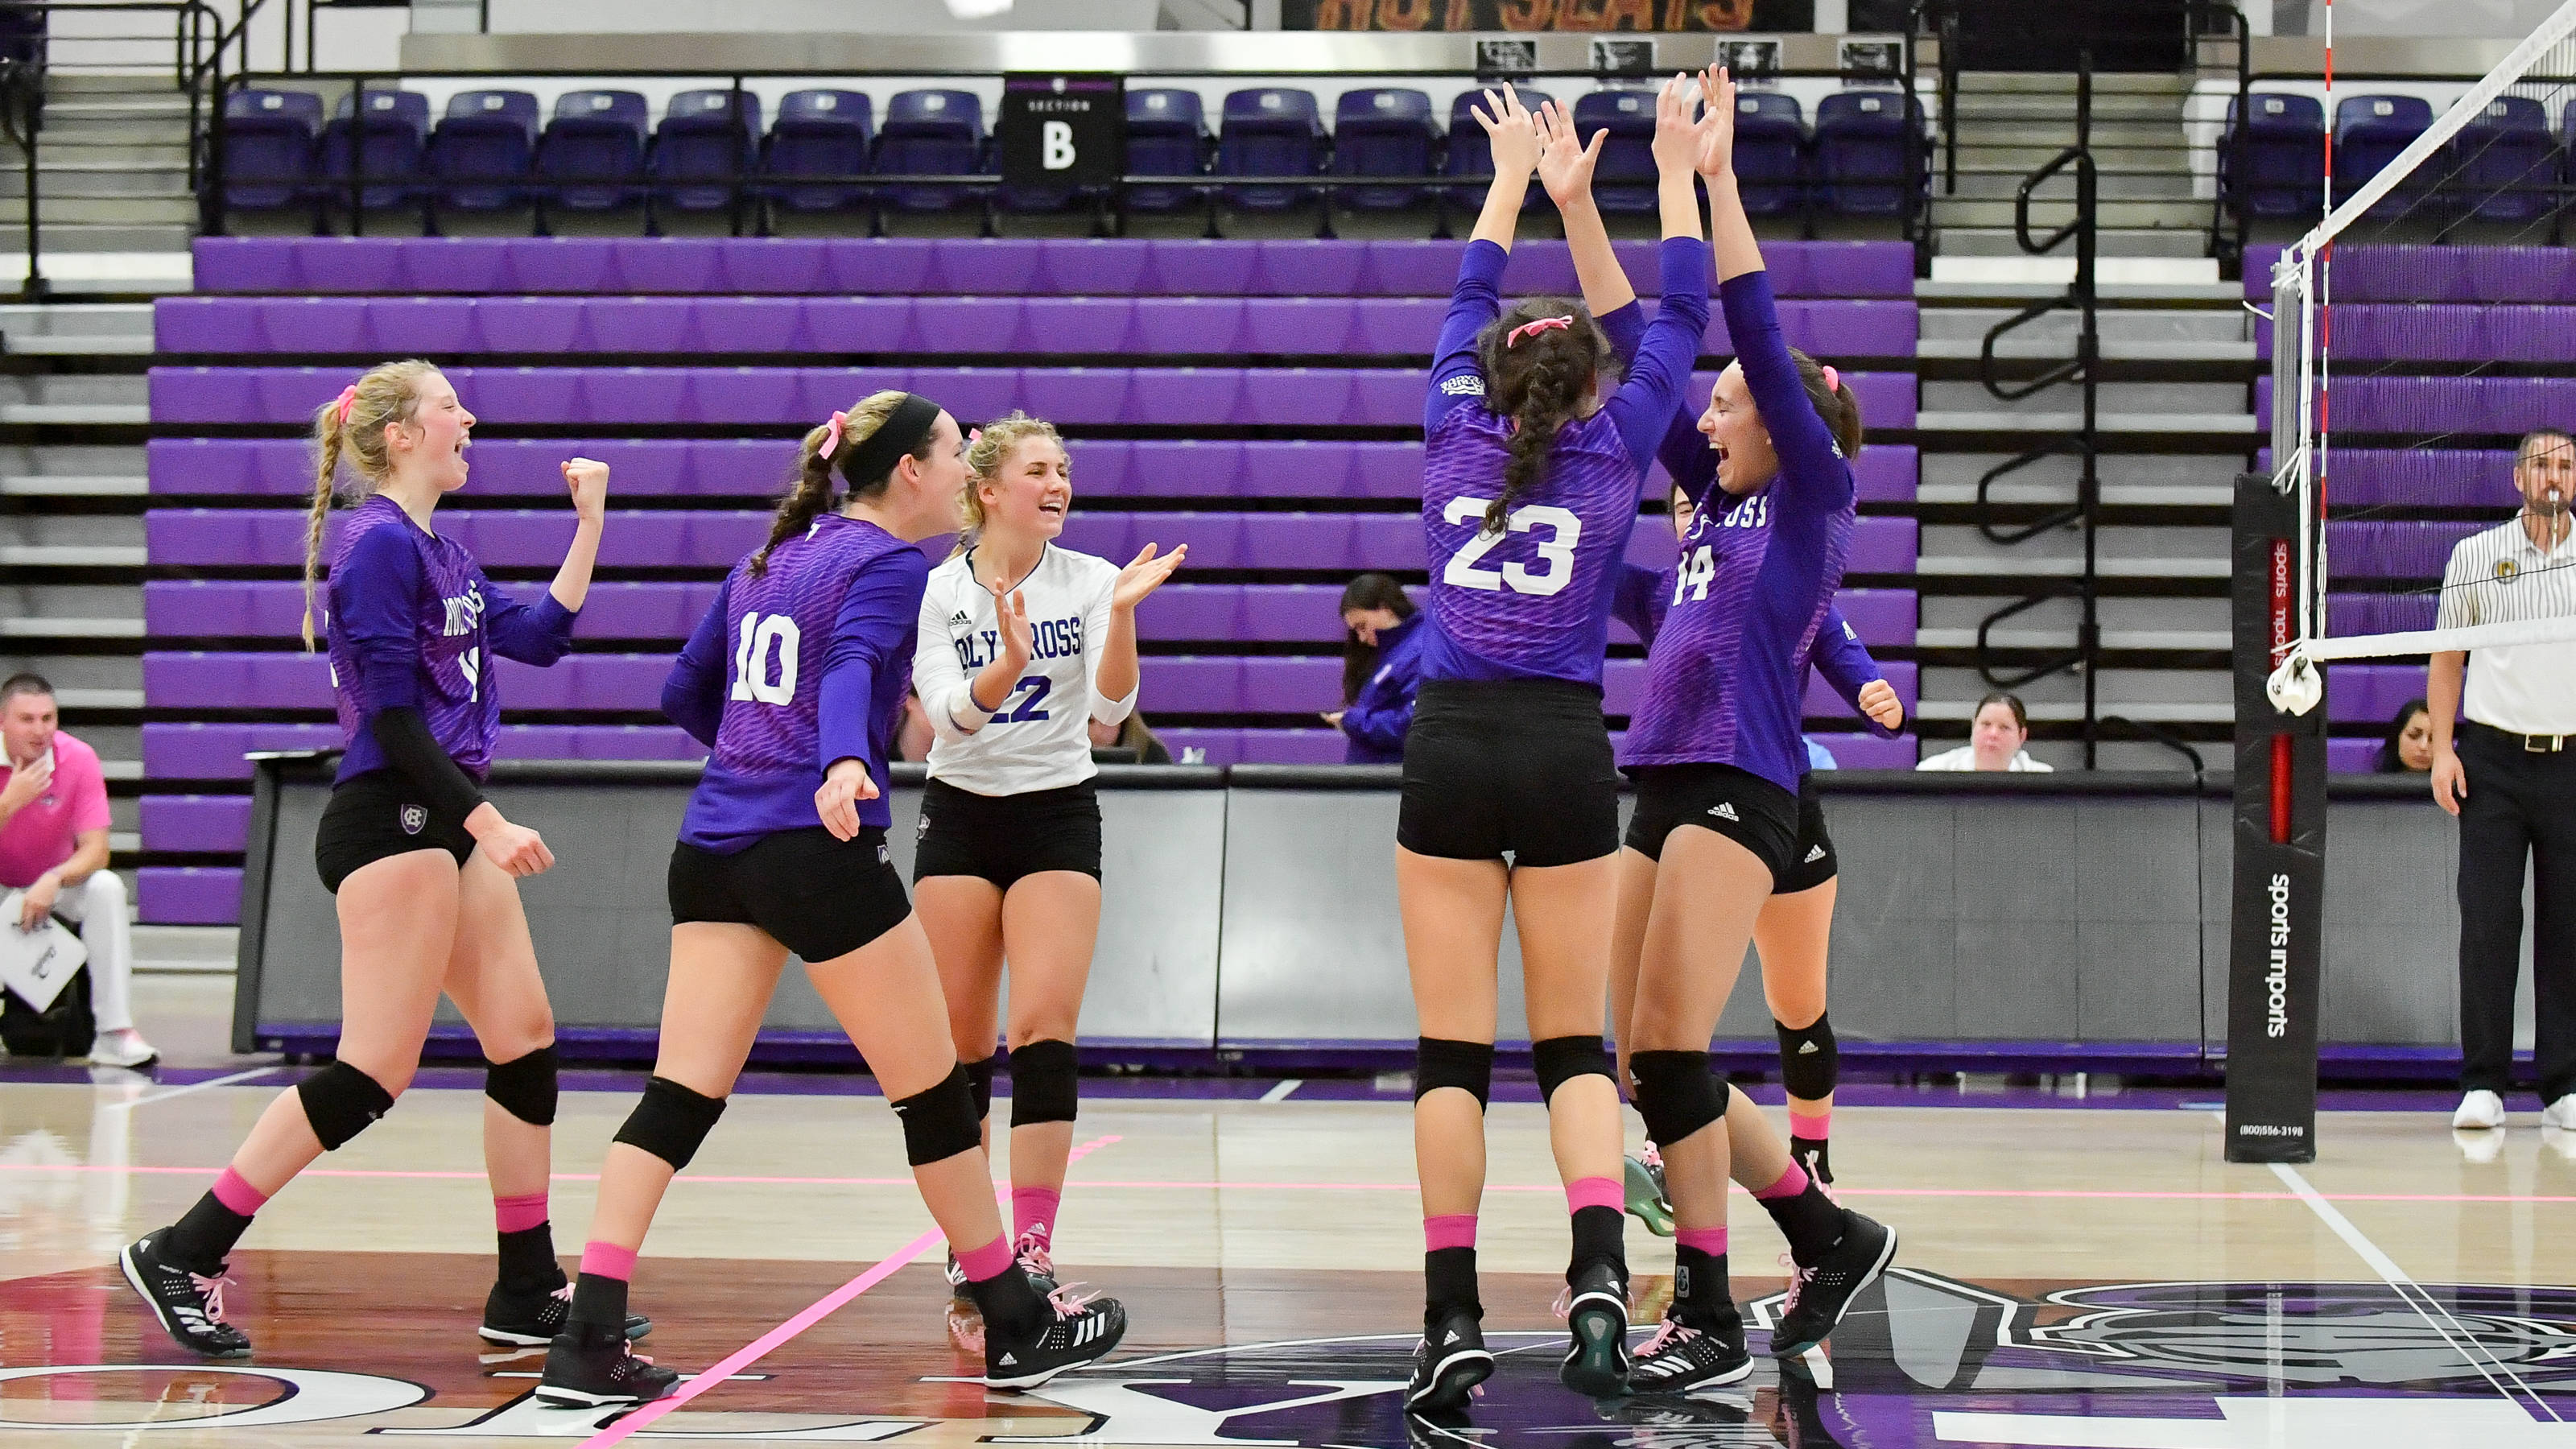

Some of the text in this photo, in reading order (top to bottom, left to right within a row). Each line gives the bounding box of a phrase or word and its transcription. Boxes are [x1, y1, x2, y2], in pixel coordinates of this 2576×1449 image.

[1028, 99, 1091, 112] SECTION
[1042, 121, 1076, 170] B
[1443, 496, 1582, 596] 23
[2274, 542, 2288, 597] sports
[1672, 545, 1716, 607] 14
[731, 612, 801, 706] 10
[955, 617, 1081, 671] OLY ROSS
[1707, 809, 1740, 822] adidas
[2264, 873, 2291, 1038] sports imports
